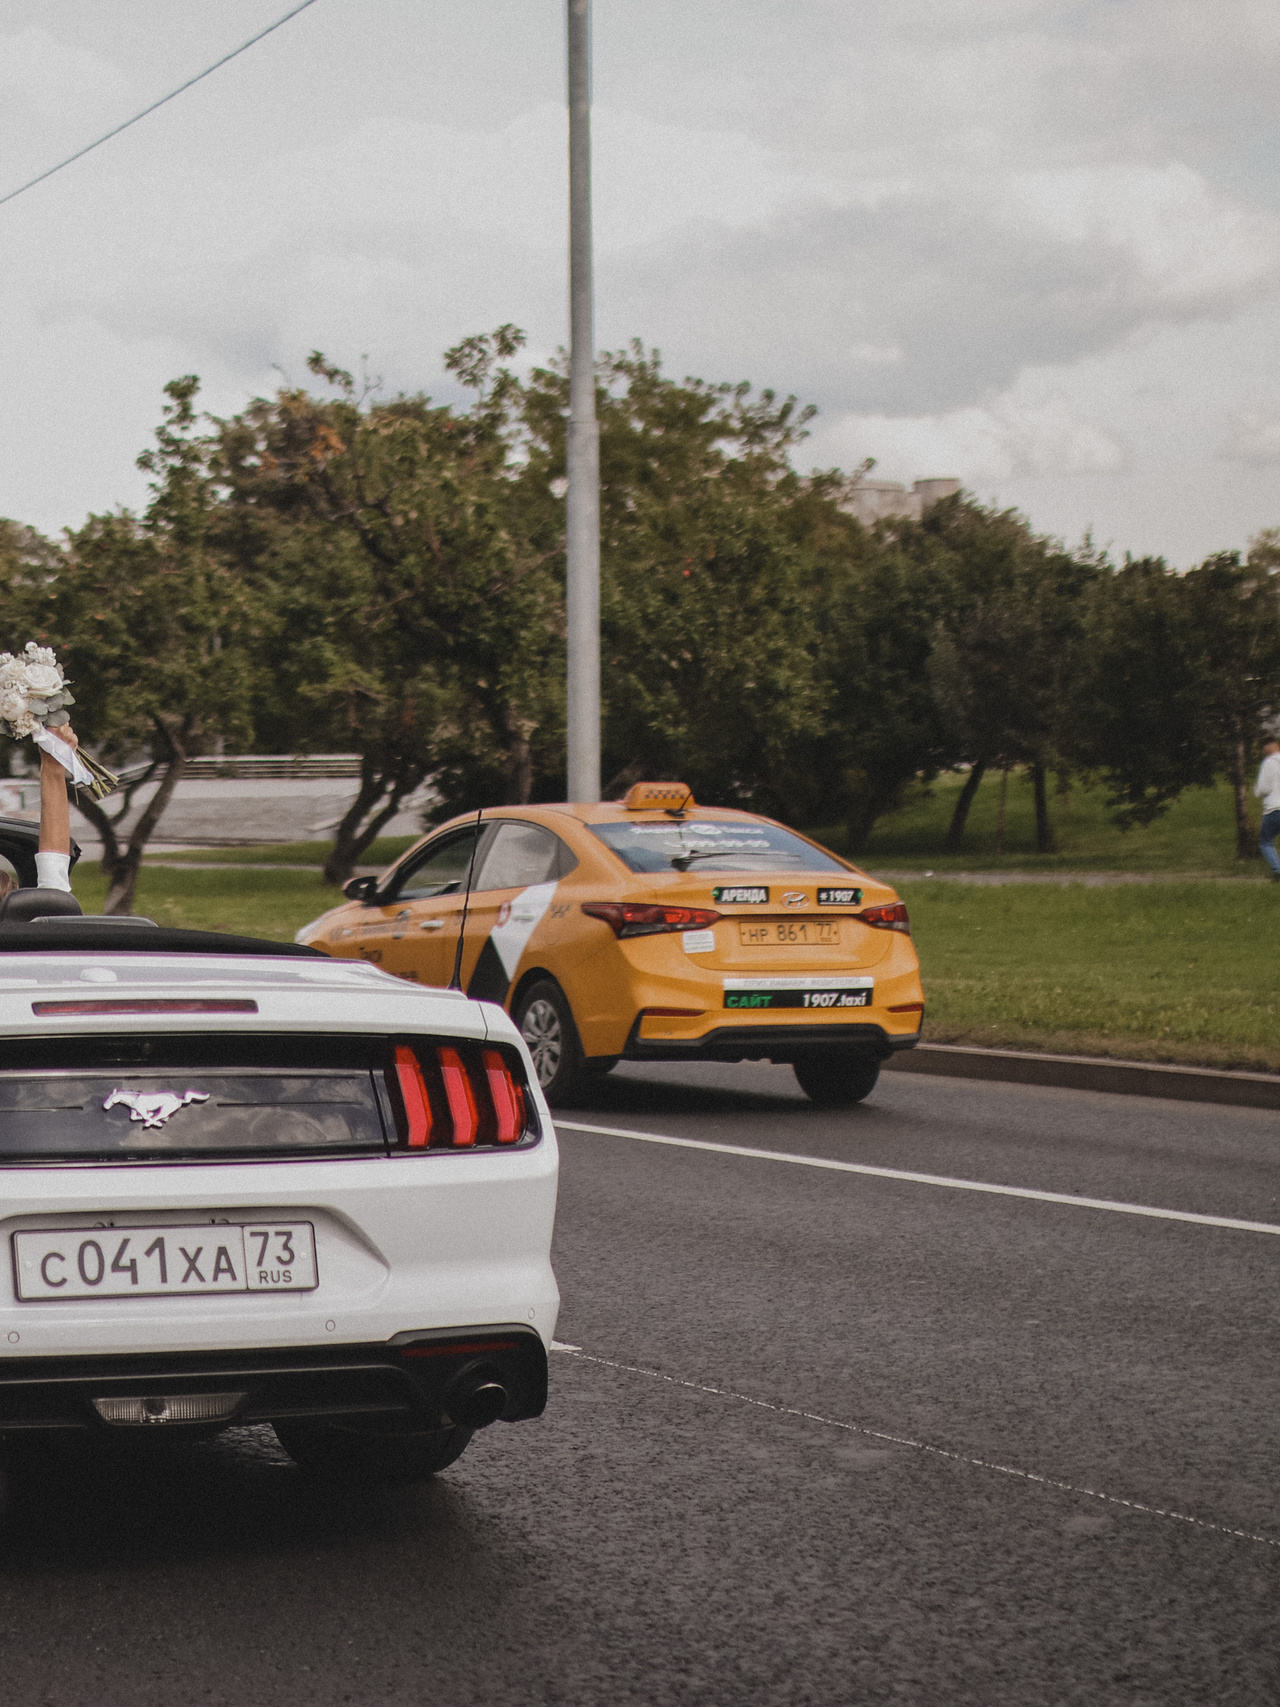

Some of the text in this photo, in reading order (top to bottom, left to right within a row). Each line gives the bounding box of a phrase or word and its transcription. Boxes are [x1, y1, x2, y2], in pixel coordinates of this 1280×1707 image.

[721, 888, 767, 904] АРЕНДА
[777, 923, 808, 942] 861
[816, 922, 833, 937] 77
[726, 993, 772, 1008] САЙТ
[803, 992, 867, 1007] 1907.taxi
[249, 1231, 296, 1267] 73
[258, 1270, 293, 1284] RUS
